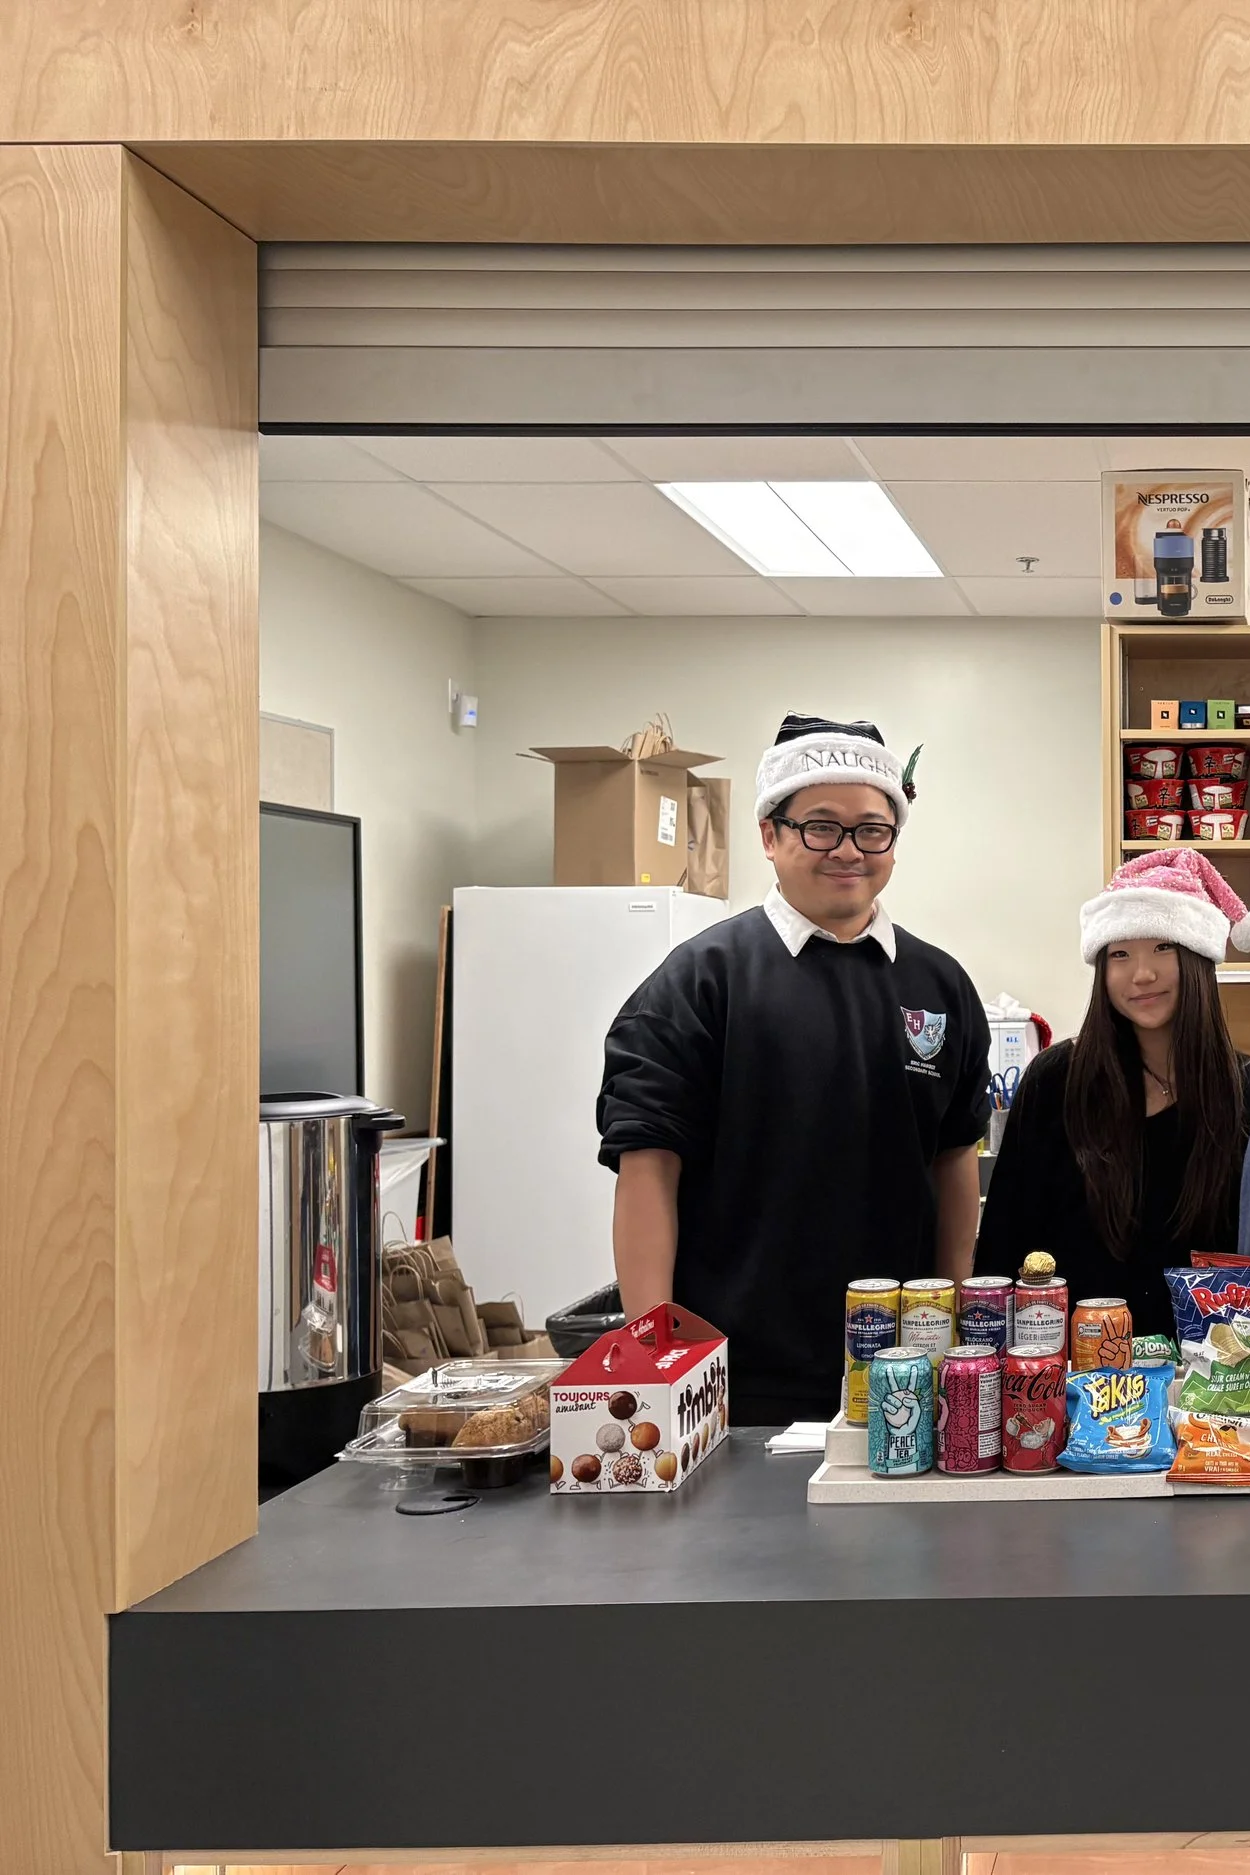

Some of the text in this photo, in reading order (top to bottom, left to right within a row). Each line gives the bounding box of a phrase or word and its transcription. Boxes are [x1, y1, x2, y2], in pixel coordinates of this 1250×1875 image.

[1137, 492, 1210, 506] NESPRESSO
[1226, 1373, 1245, 1382] CREAM
[553, 1391, 610, 1402] TOUJOURS
[677, 1356, 726, 1438] timbits
[555, 1401, 597, 1414] amusant
[890, 1434, 915, 1449] PEACE
[895, 1449, 909, 1458] TEA
